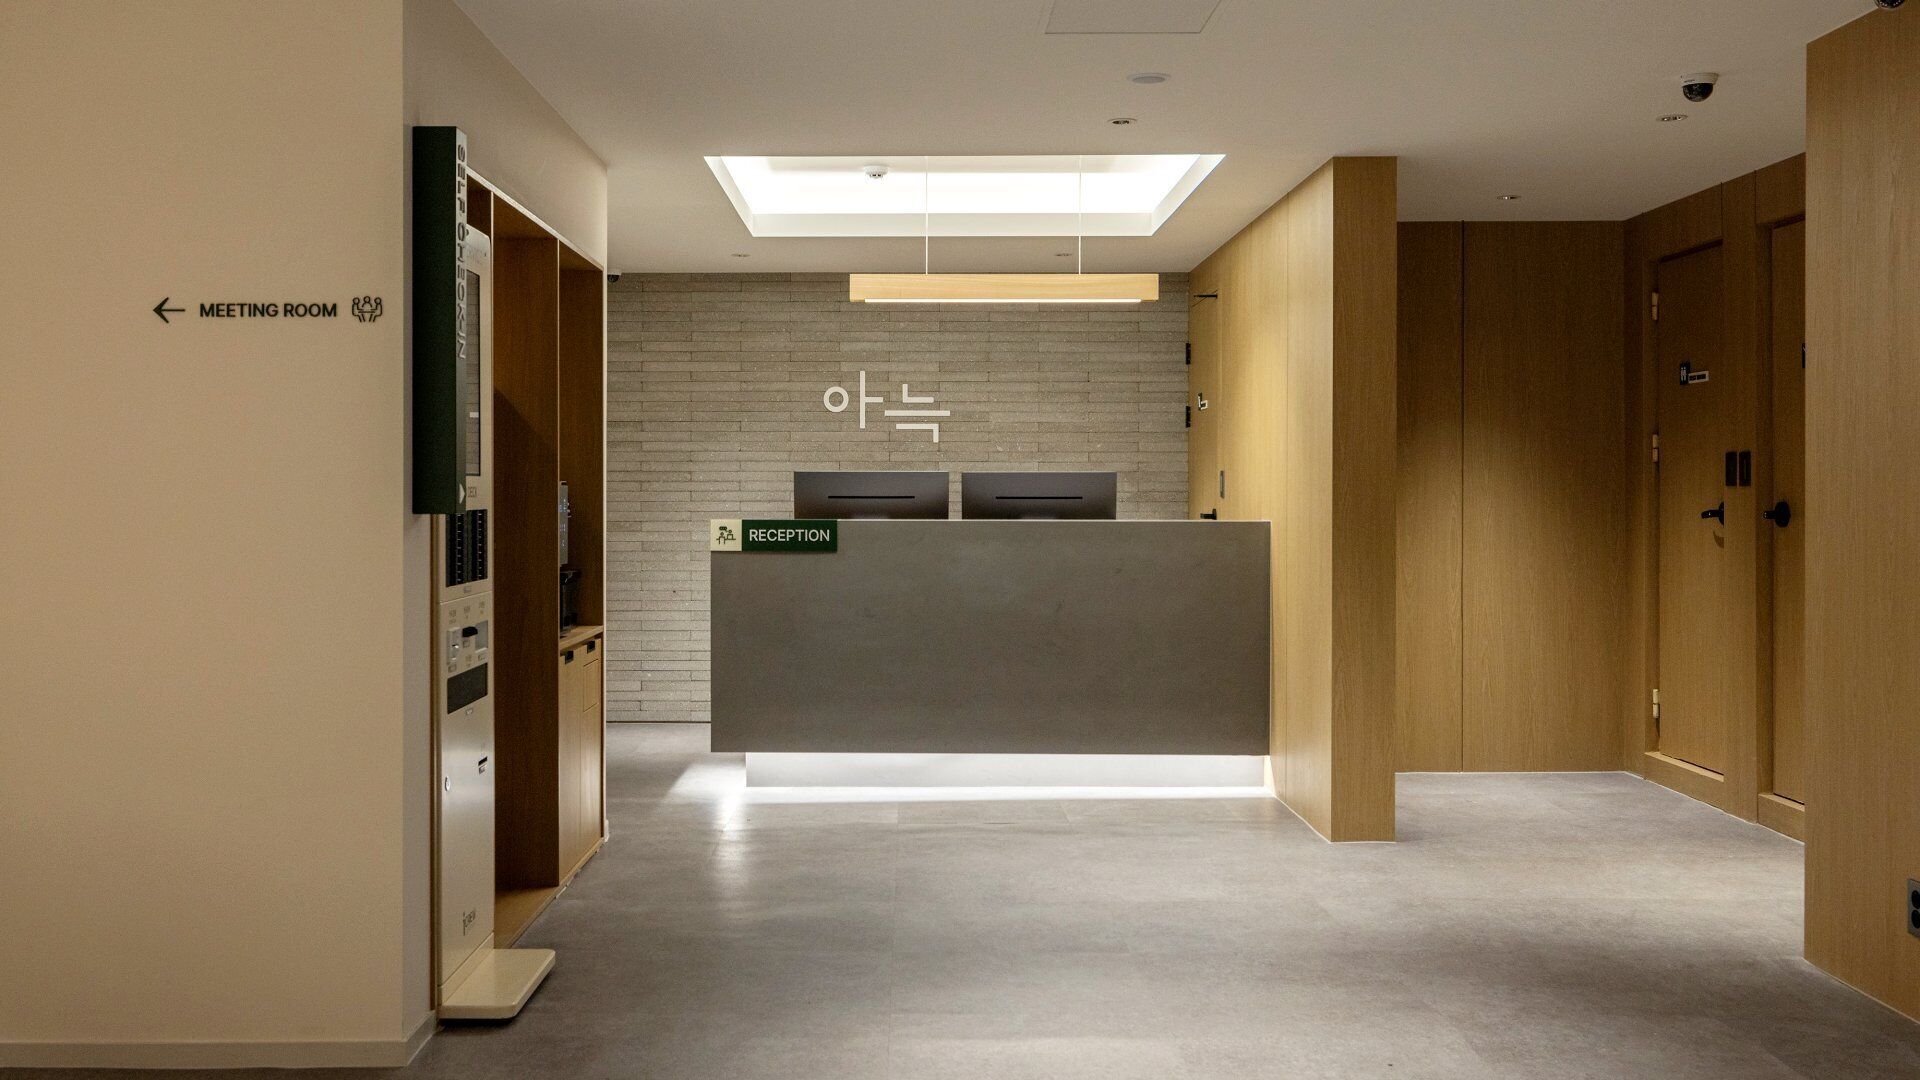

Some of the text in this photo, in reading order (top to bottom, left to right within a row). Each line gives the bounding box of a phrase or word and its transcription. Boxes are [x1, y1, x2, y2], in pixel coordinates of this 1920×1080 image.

[457, 144, 467, 214] SELF
[199, 302, 337, 318] MEETING ROOM
[823, 370, 951, 443] 아늑
[749, 529, 831, 543] RECEPTION
